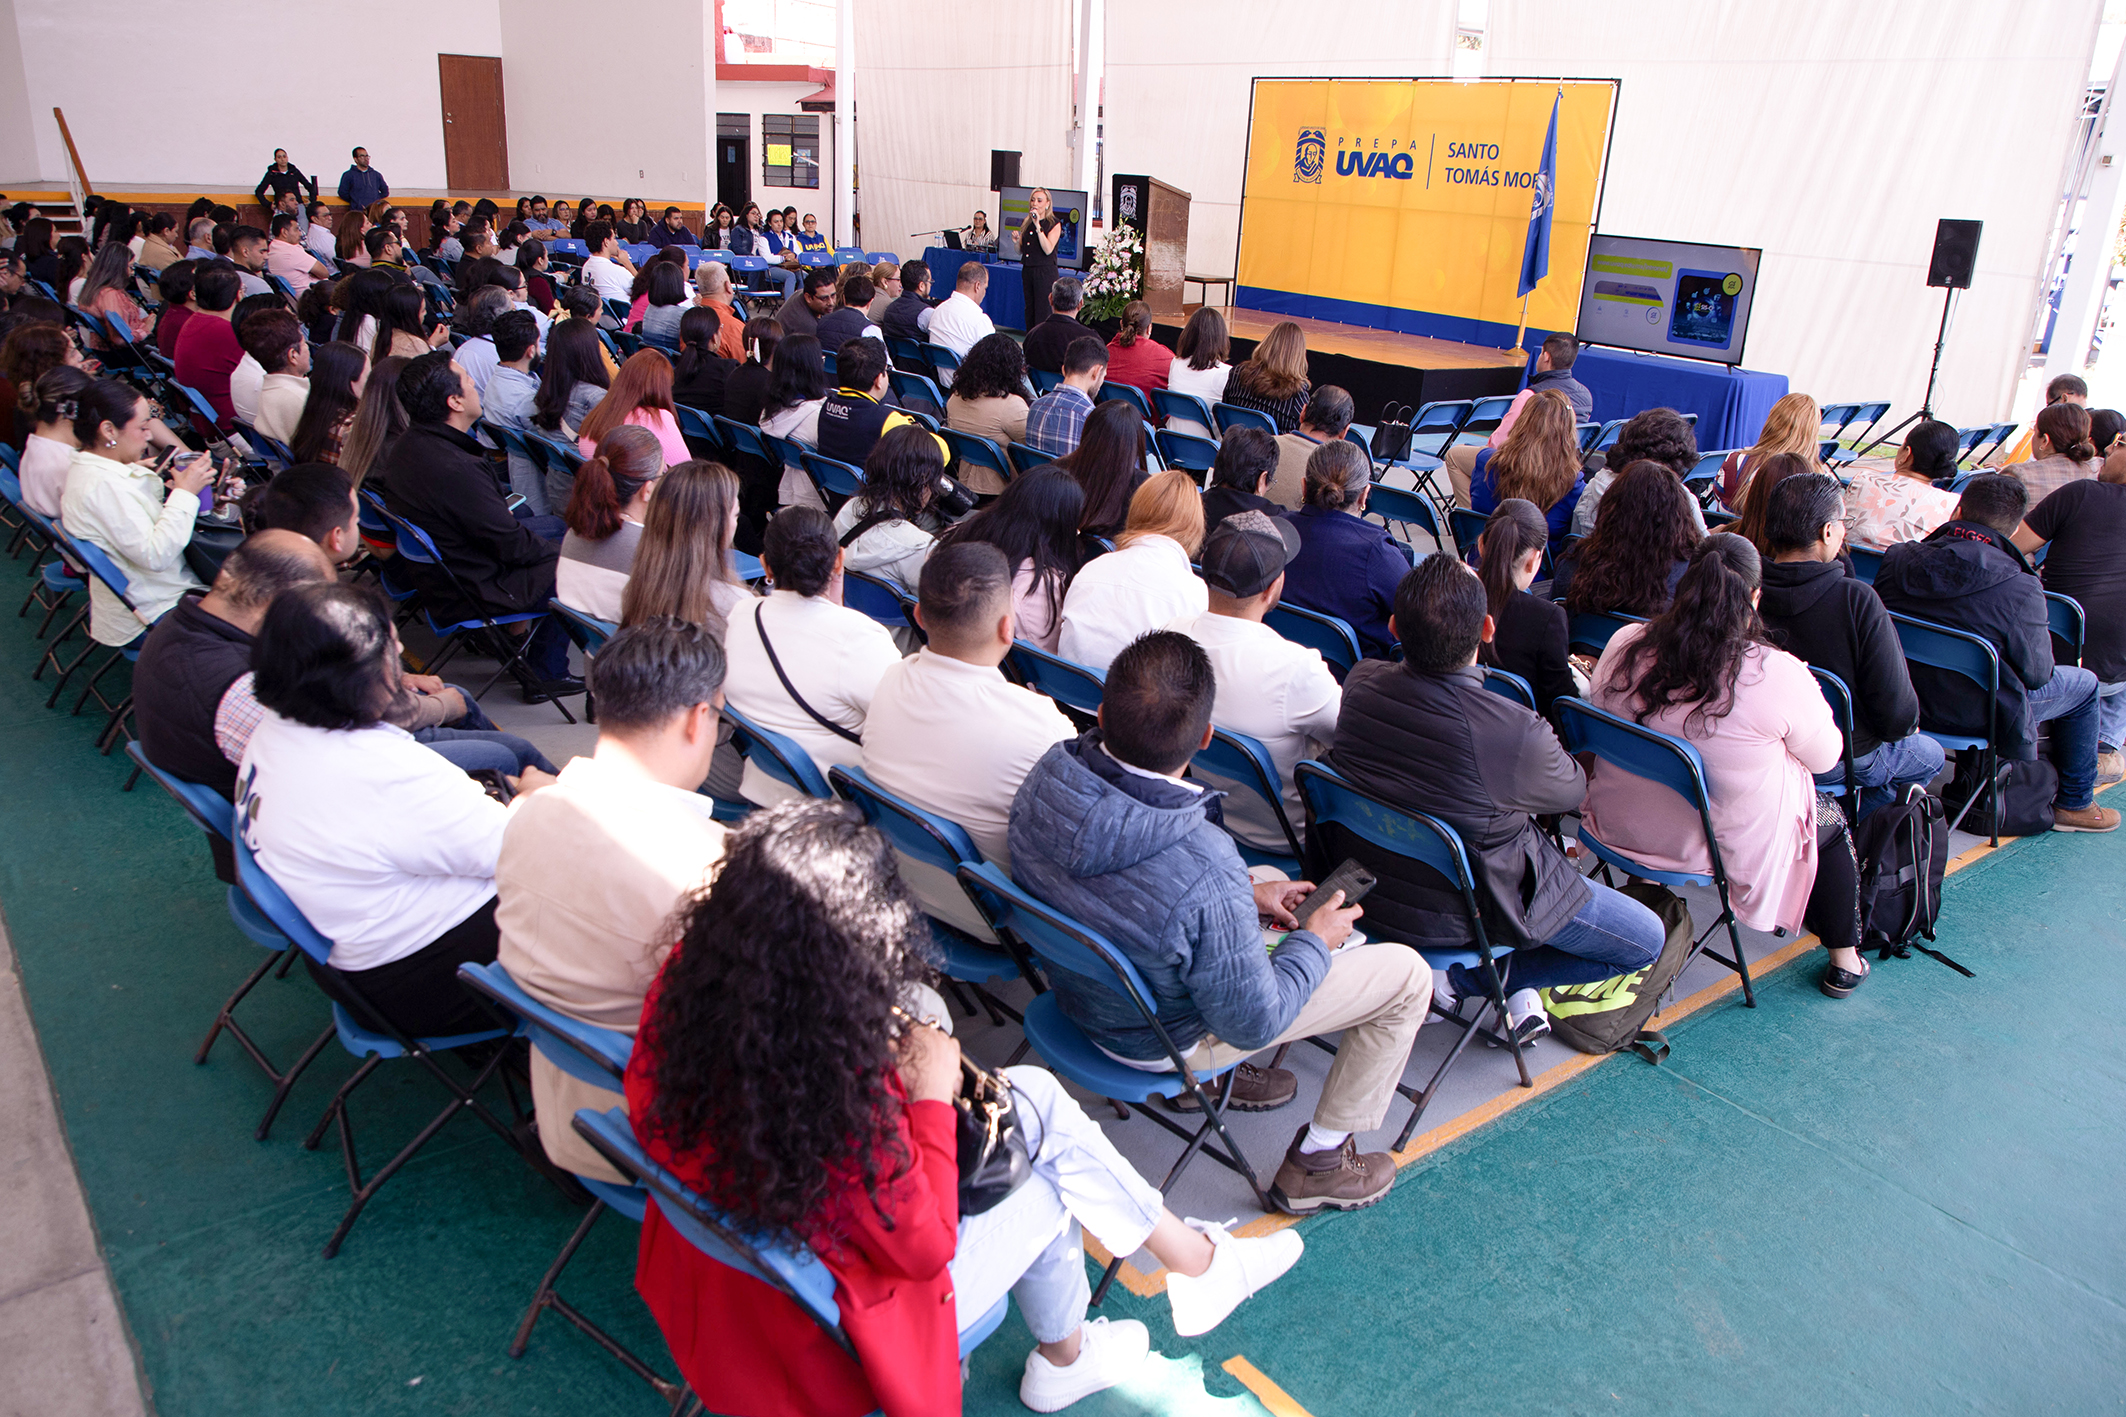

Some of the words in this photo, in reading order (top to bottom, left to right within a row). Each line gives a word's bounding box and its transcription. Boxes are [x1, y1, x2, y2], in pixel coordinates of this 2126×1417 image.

[1338, 136, 1417, 150] PREPA
[1447, 141, 1500, 161] SANTO
[1335, 150, 1414, 180] UVAQ
[1444, 165, 1500, 187] TOMÁS
[1503, 170, 1540, 189] MOR
[826, 401, 849, 417] UVAQ
